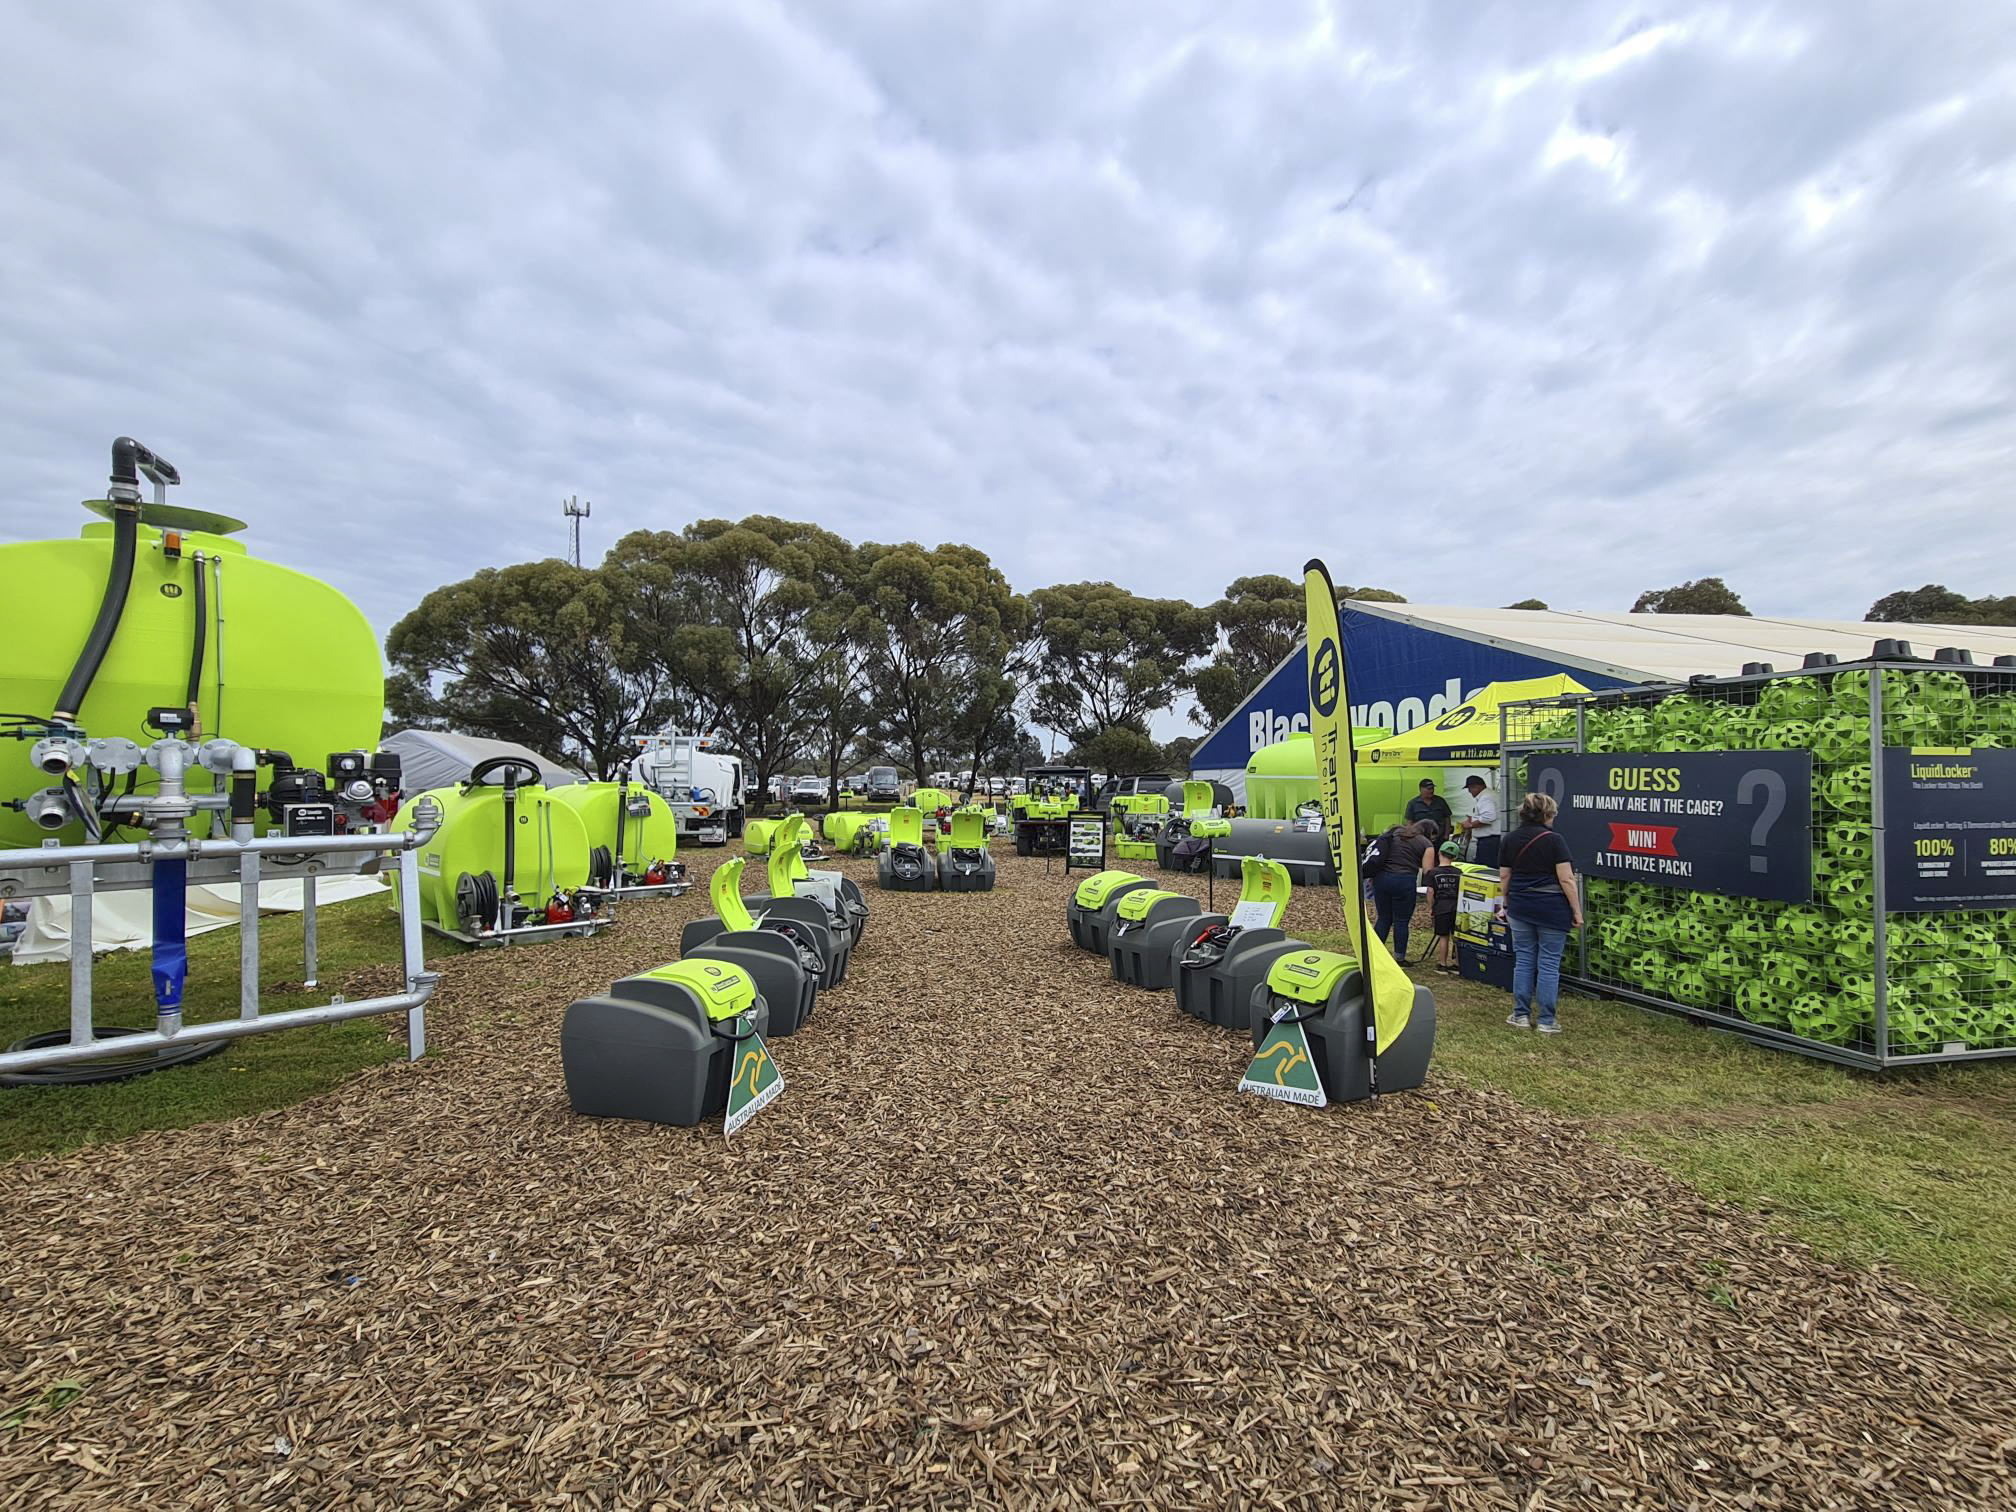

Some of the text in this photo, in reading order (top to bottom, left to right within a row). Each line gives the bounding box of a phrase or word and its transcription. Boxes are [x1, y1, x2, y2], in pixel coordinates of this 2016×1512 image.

[1250, 678, 1487, 752] Blacood
[1450, 747, 1501, 759] www.tti.com.a
[1609, 767, 1681, 792] GUESS
[1573, 794, 1723, 816] HOW MANY ARE IN THE CAGE?
[1627, 829, 1657, 848] WIN!
[1914, 839, 1954, 856] 100%
[1596, 852, 1692, 877] A TTI PRIZE PACK!
[1241, 1083, 1320, 1105] AUSTRALIAN MADE
[727, 1082, 782, 1131] AUSTRALIAN MADE
